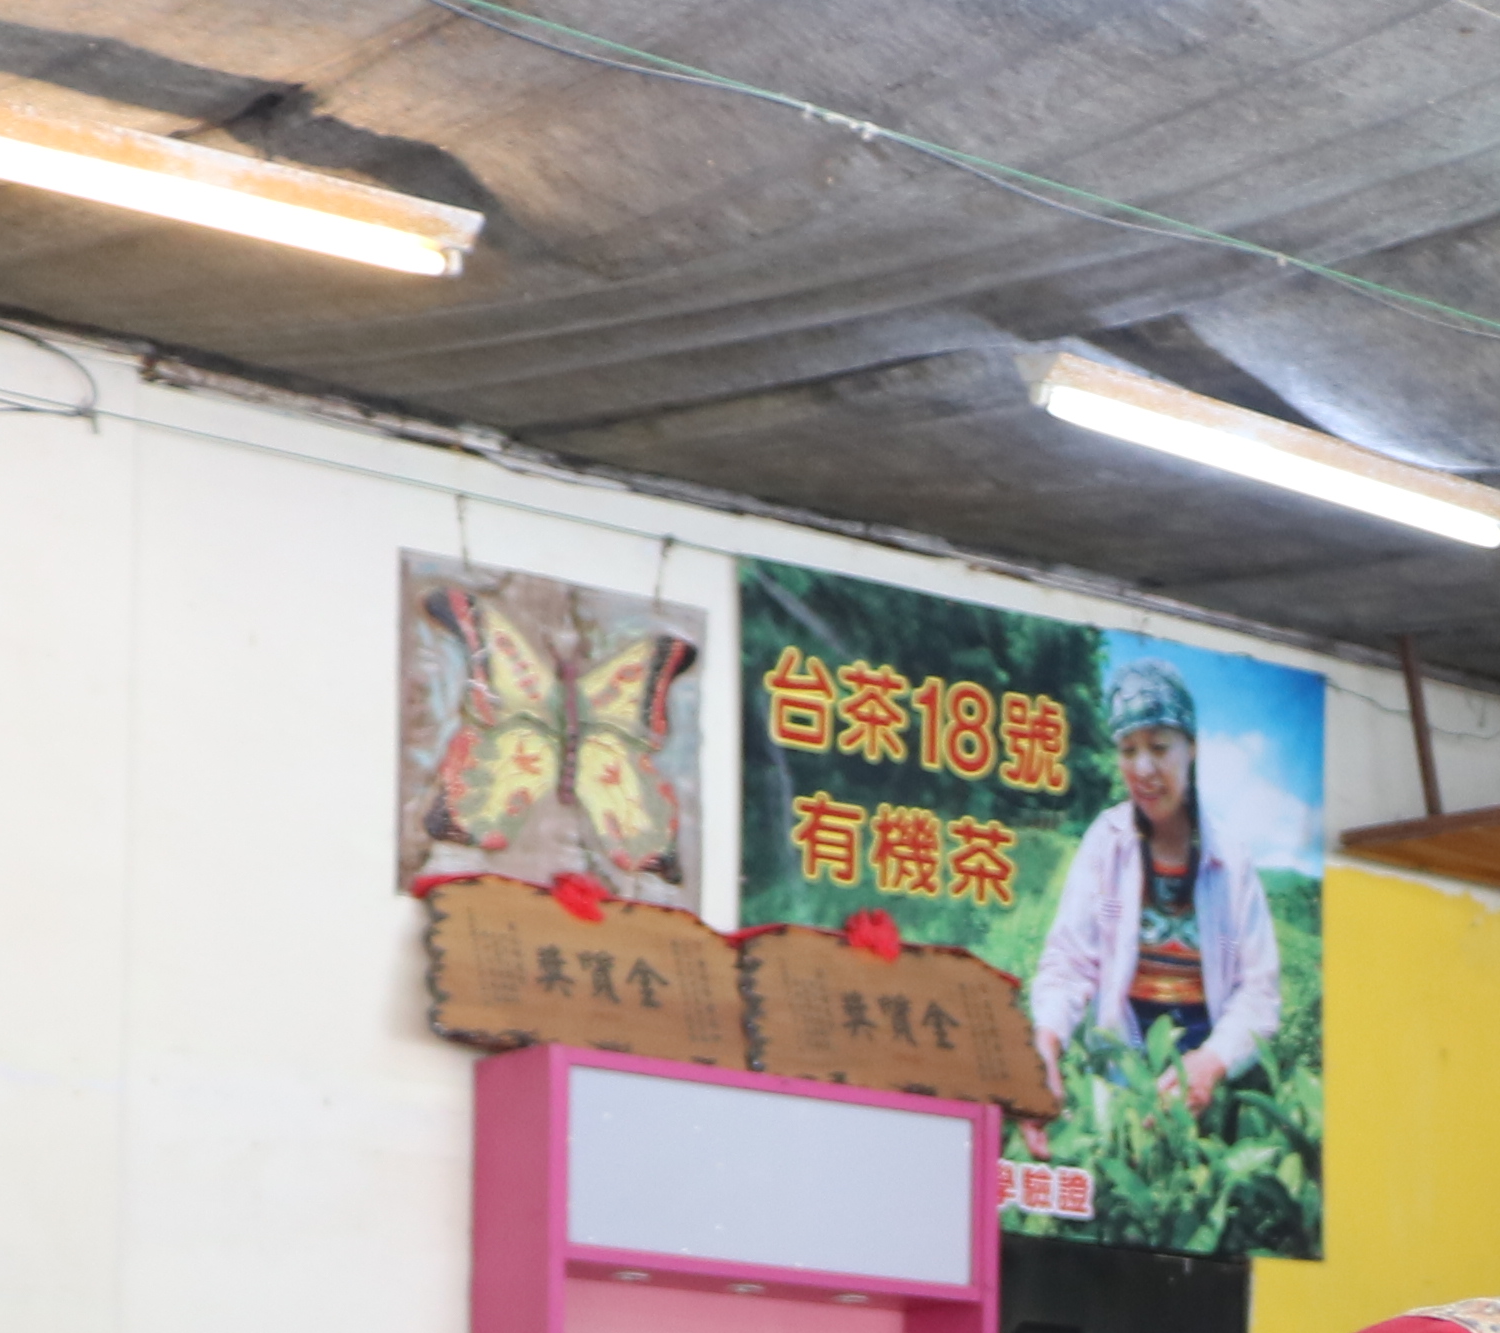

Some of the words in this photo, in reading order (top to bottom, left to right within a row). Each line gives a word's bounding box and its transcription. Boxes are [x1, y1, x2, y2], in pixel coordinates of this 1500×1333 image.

[763, 645, 1070, 796] 台茶18號
[792, 791, 1018, 906] 有機茶
